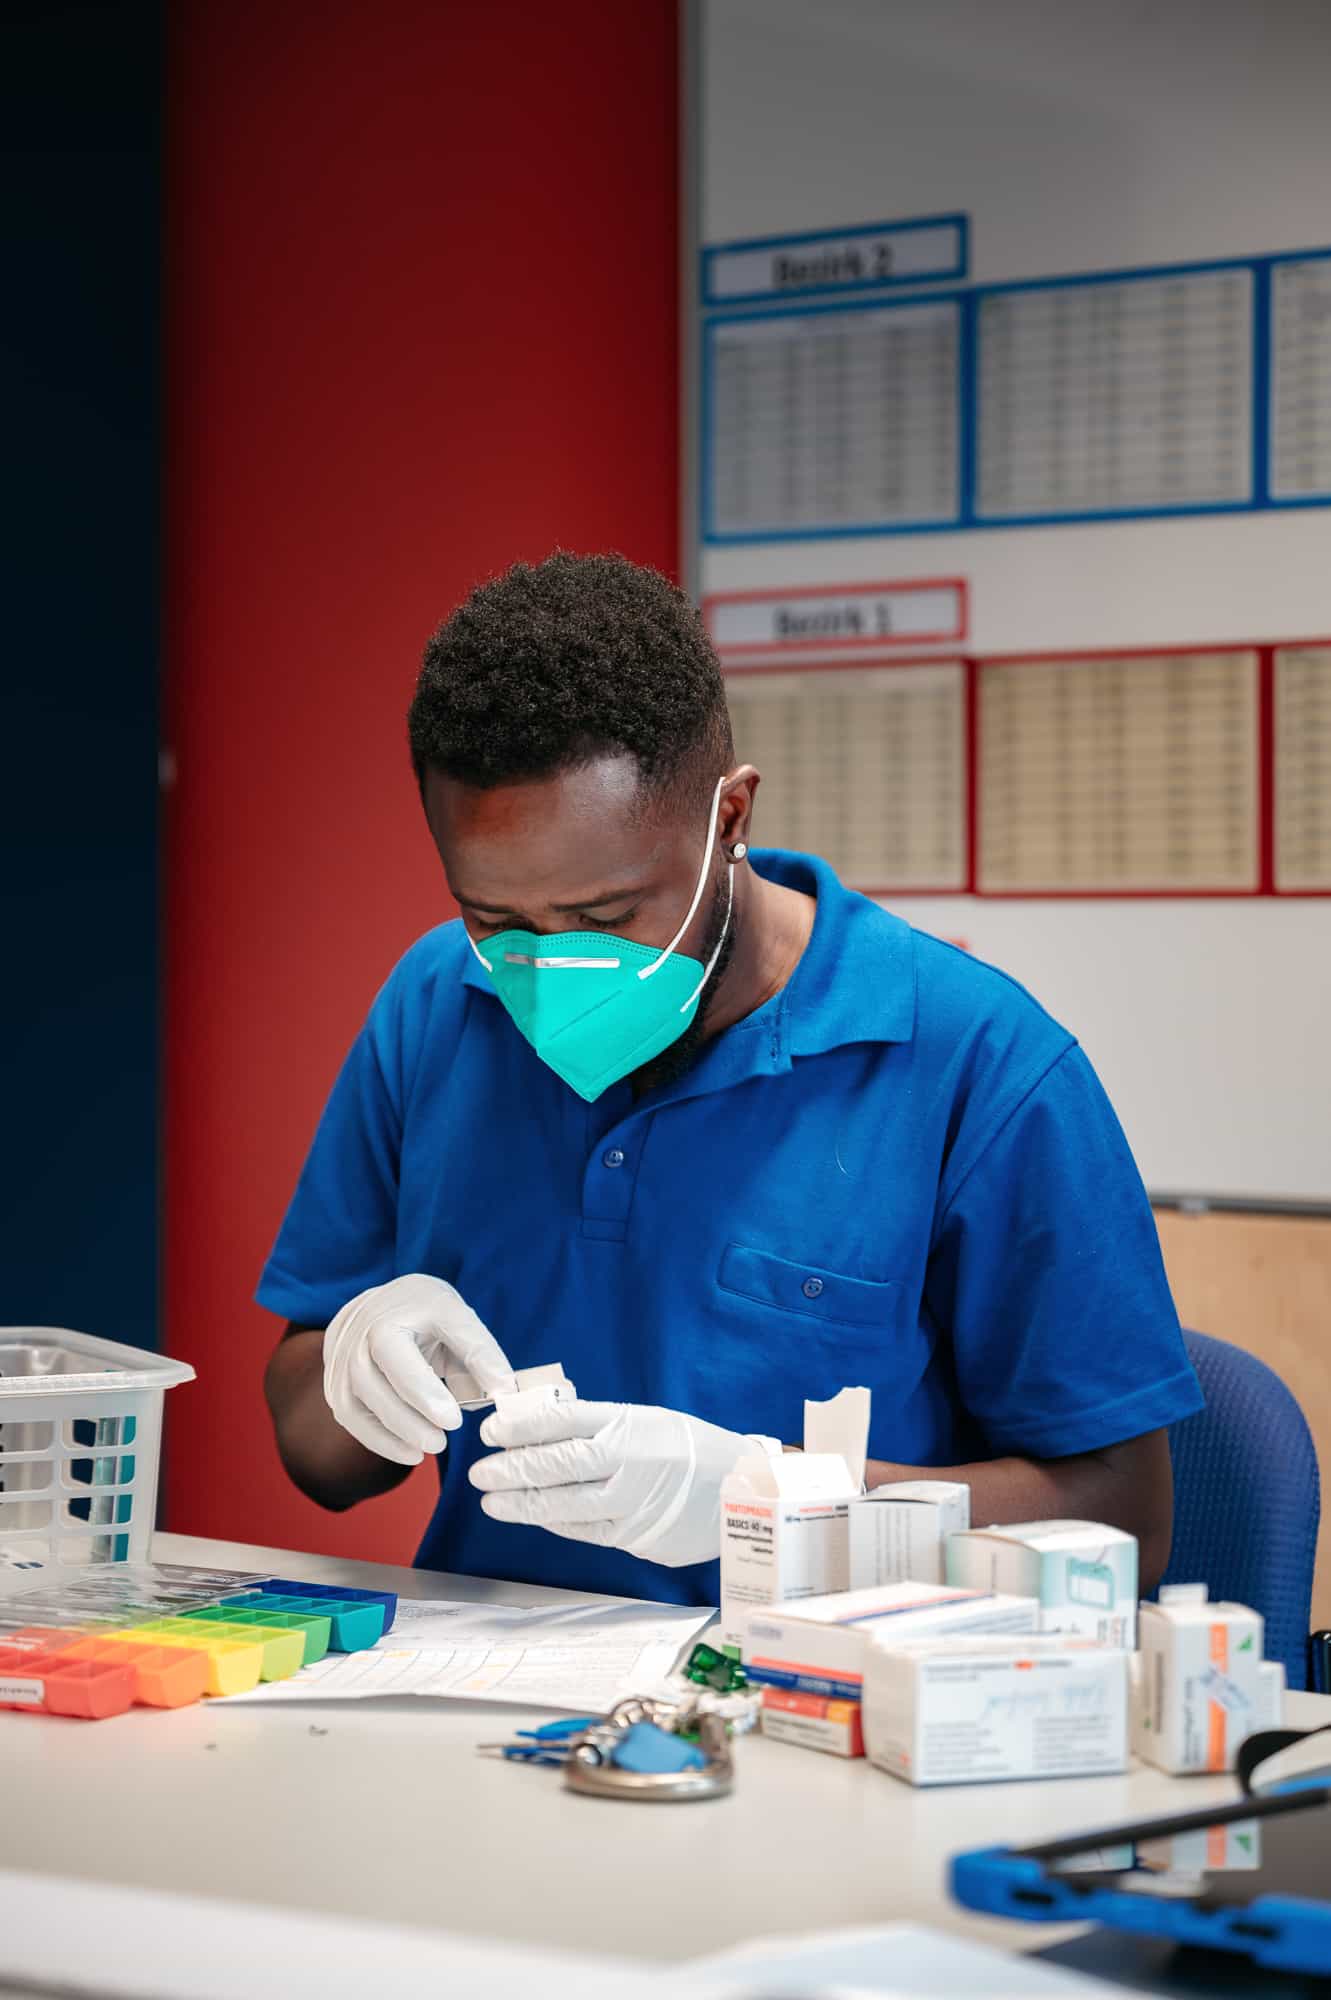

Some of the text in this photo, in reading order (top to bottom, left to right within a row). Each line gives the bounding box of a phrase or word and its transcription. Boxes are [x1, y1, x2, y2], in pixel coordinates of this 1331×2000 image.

[772, 241, 894, 288] Bezirk 2
[772, 600, 891, 639] Bezirk 1
[727, 1518, 749, 1531] BASICS
